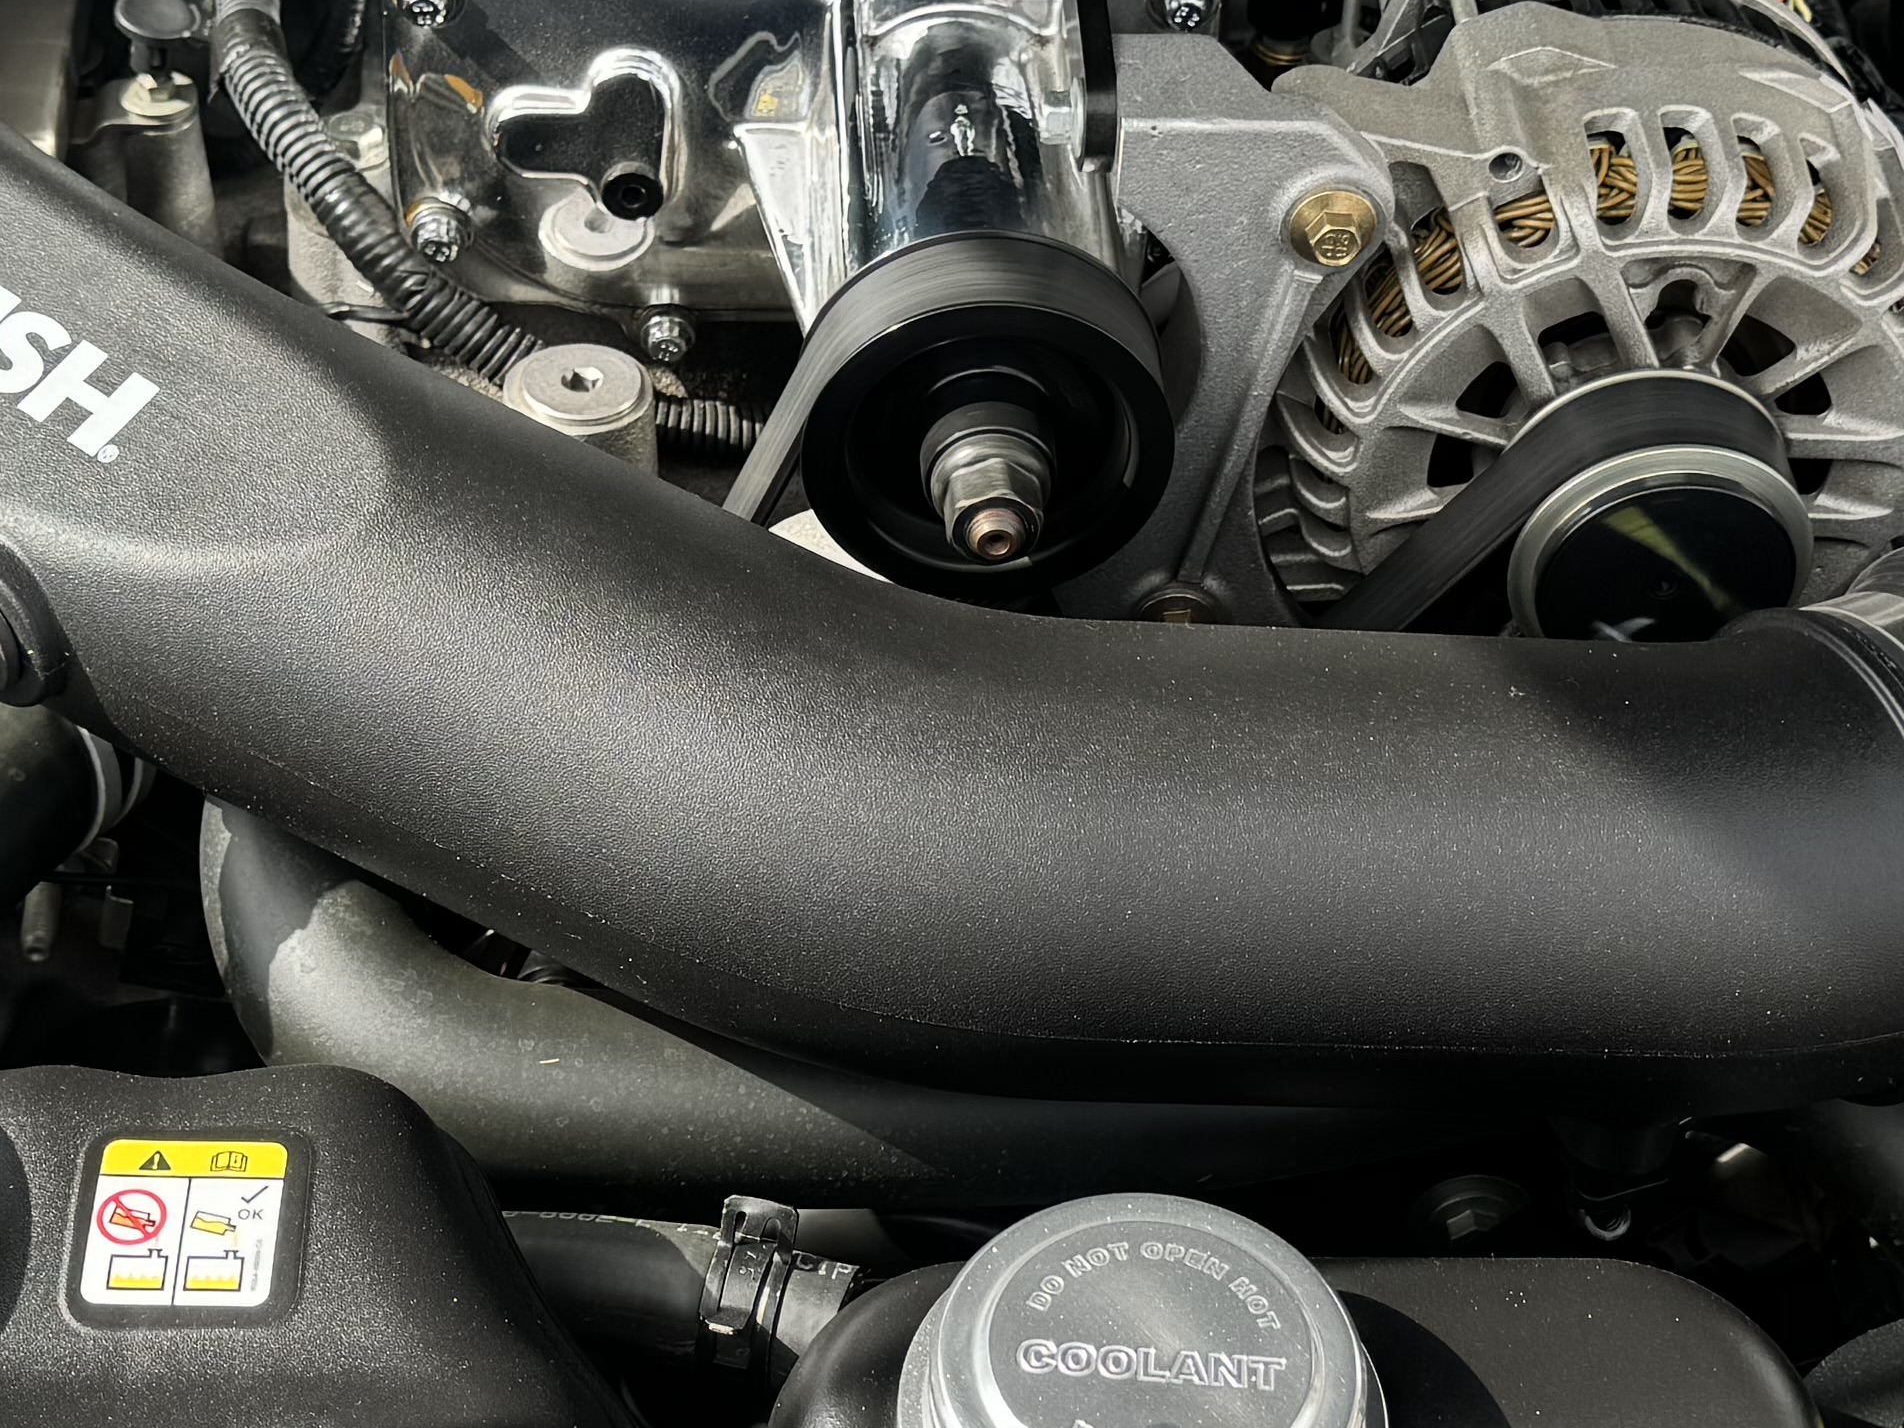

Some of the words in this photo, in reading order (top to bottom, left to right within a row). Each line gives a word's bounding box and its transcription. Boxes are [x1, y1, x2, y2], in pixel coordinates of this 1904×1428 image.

[237, 1208, 265, 1221] OK
[1026, 1276, 1065, 1314] DO
[1062, 1241, 1130, 1280] NOT
[1140, 1240, 1228, 1279] OPEN
[1228, 1274, 1281, 1332] HOT
[1015, 1338, 1288, 1392] COOLANT
